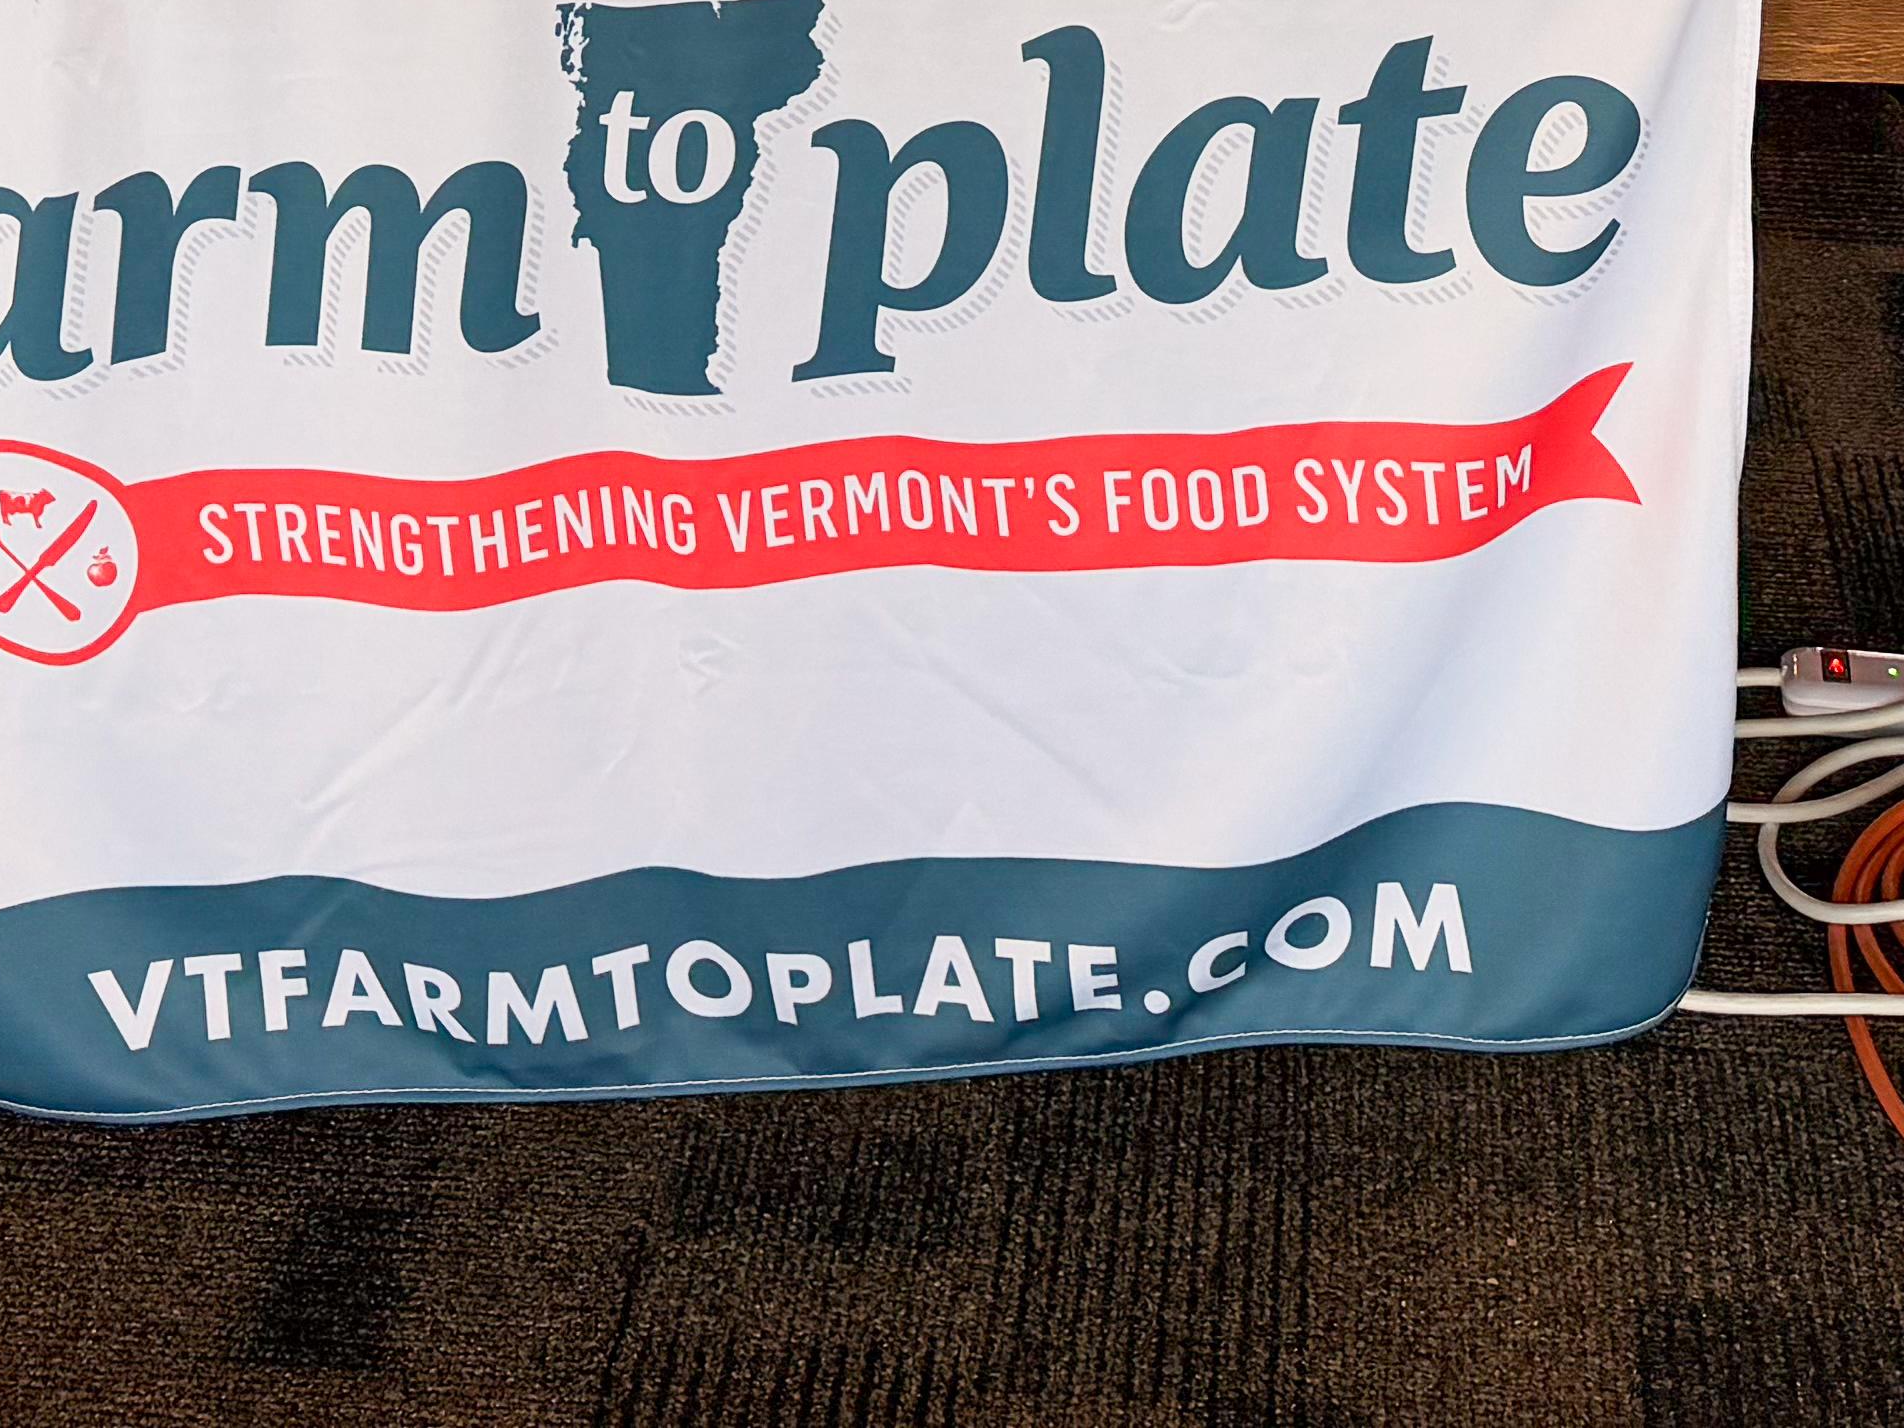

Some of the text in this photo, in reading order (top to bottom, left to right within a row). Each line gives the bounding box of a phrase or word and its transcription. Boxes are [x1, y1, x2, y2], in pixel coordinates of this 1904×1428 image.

[600, 92, 736, 204] to
[792, 26, 1642, 382] plate
[200, 444, 1532, 576] STRENGTHENING VERMONT'S FOOD SYSTEM
[88, 881, 1473, 1051] VTFARMTOPLATE.COM
